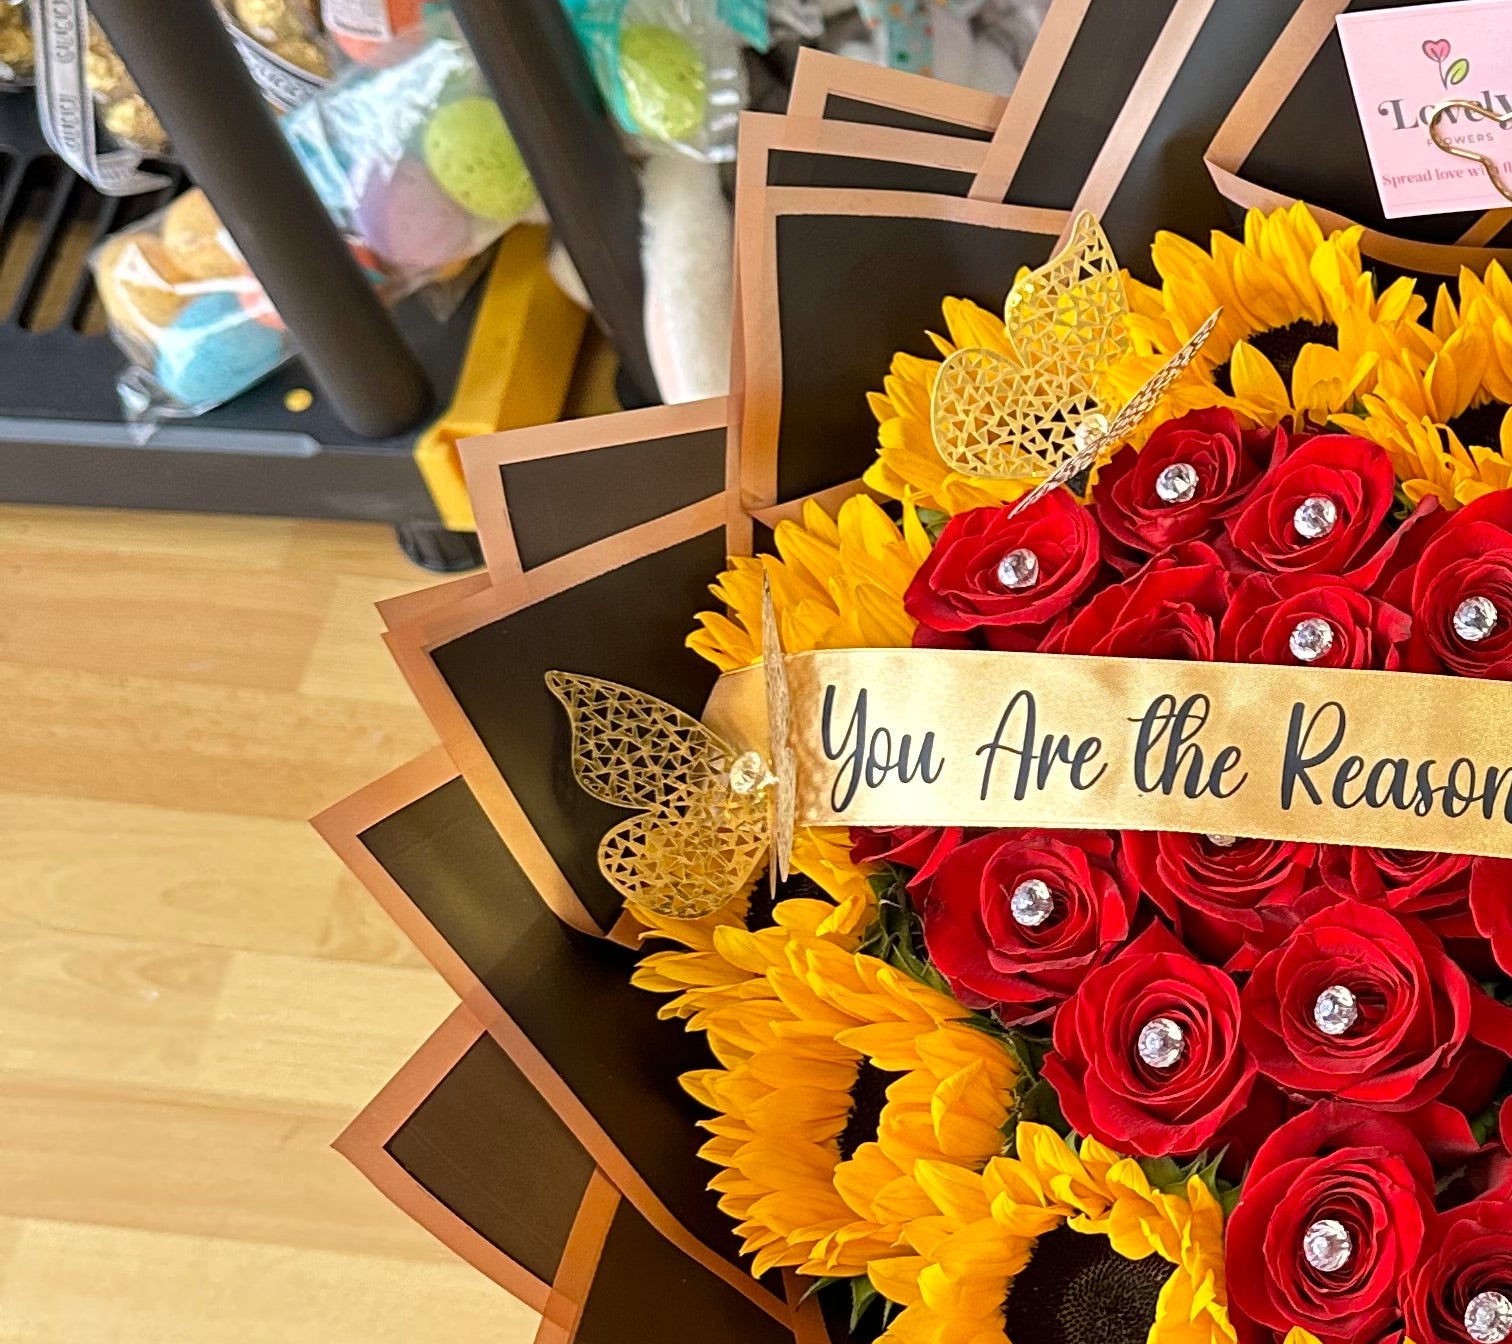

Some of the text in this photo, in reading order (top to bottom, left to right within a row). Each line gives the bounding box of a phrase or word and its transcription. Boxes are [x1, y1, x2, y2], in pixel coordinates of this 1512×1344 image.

[1426, 131, 1495, 148] FOWERS
[1382, 168, 1433, 189] Spread
[1435, 167, 1465, 180] love
[1467, 164, 1499, 178] wi
[821, 683, 945, 813] You
[975, 689, 1109, 802] Are
[1127, 693, 1249, 799] the
